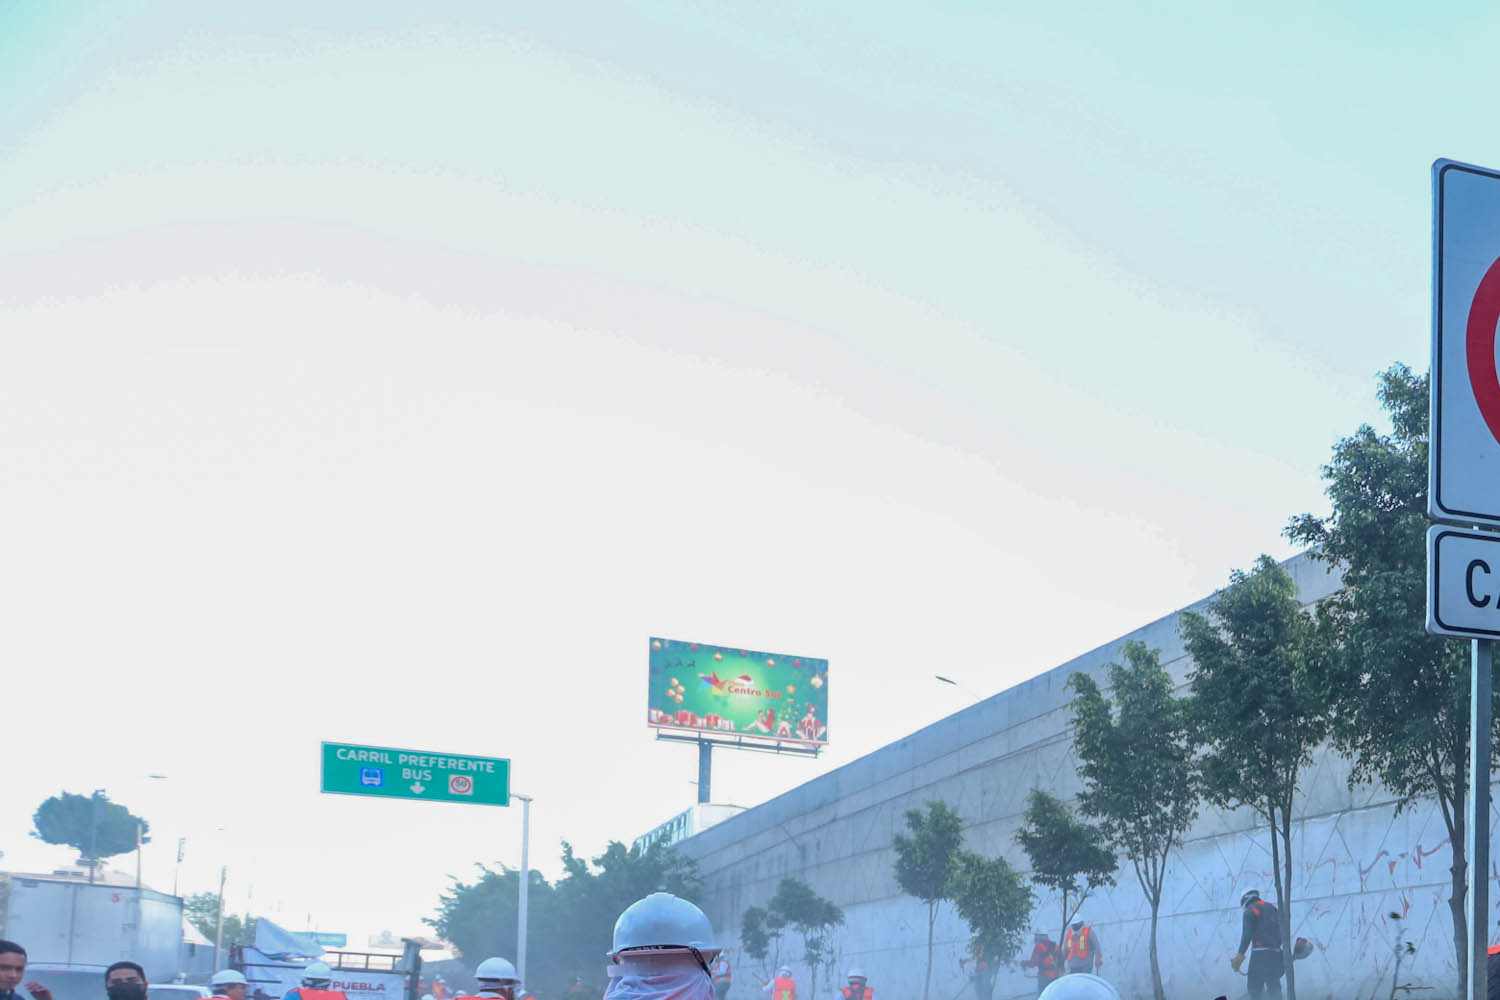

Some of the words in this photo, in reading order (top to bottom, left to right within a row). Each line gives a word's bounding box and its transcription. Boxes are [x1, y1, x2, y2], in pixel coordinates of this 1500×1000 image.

[335, 748, 393, 765] CARRIL
[397, 753, 496, 774] PREFERENTE
[401, 767, 433, 782] BUS
[331, 980, 386, 992] PUEBLA
